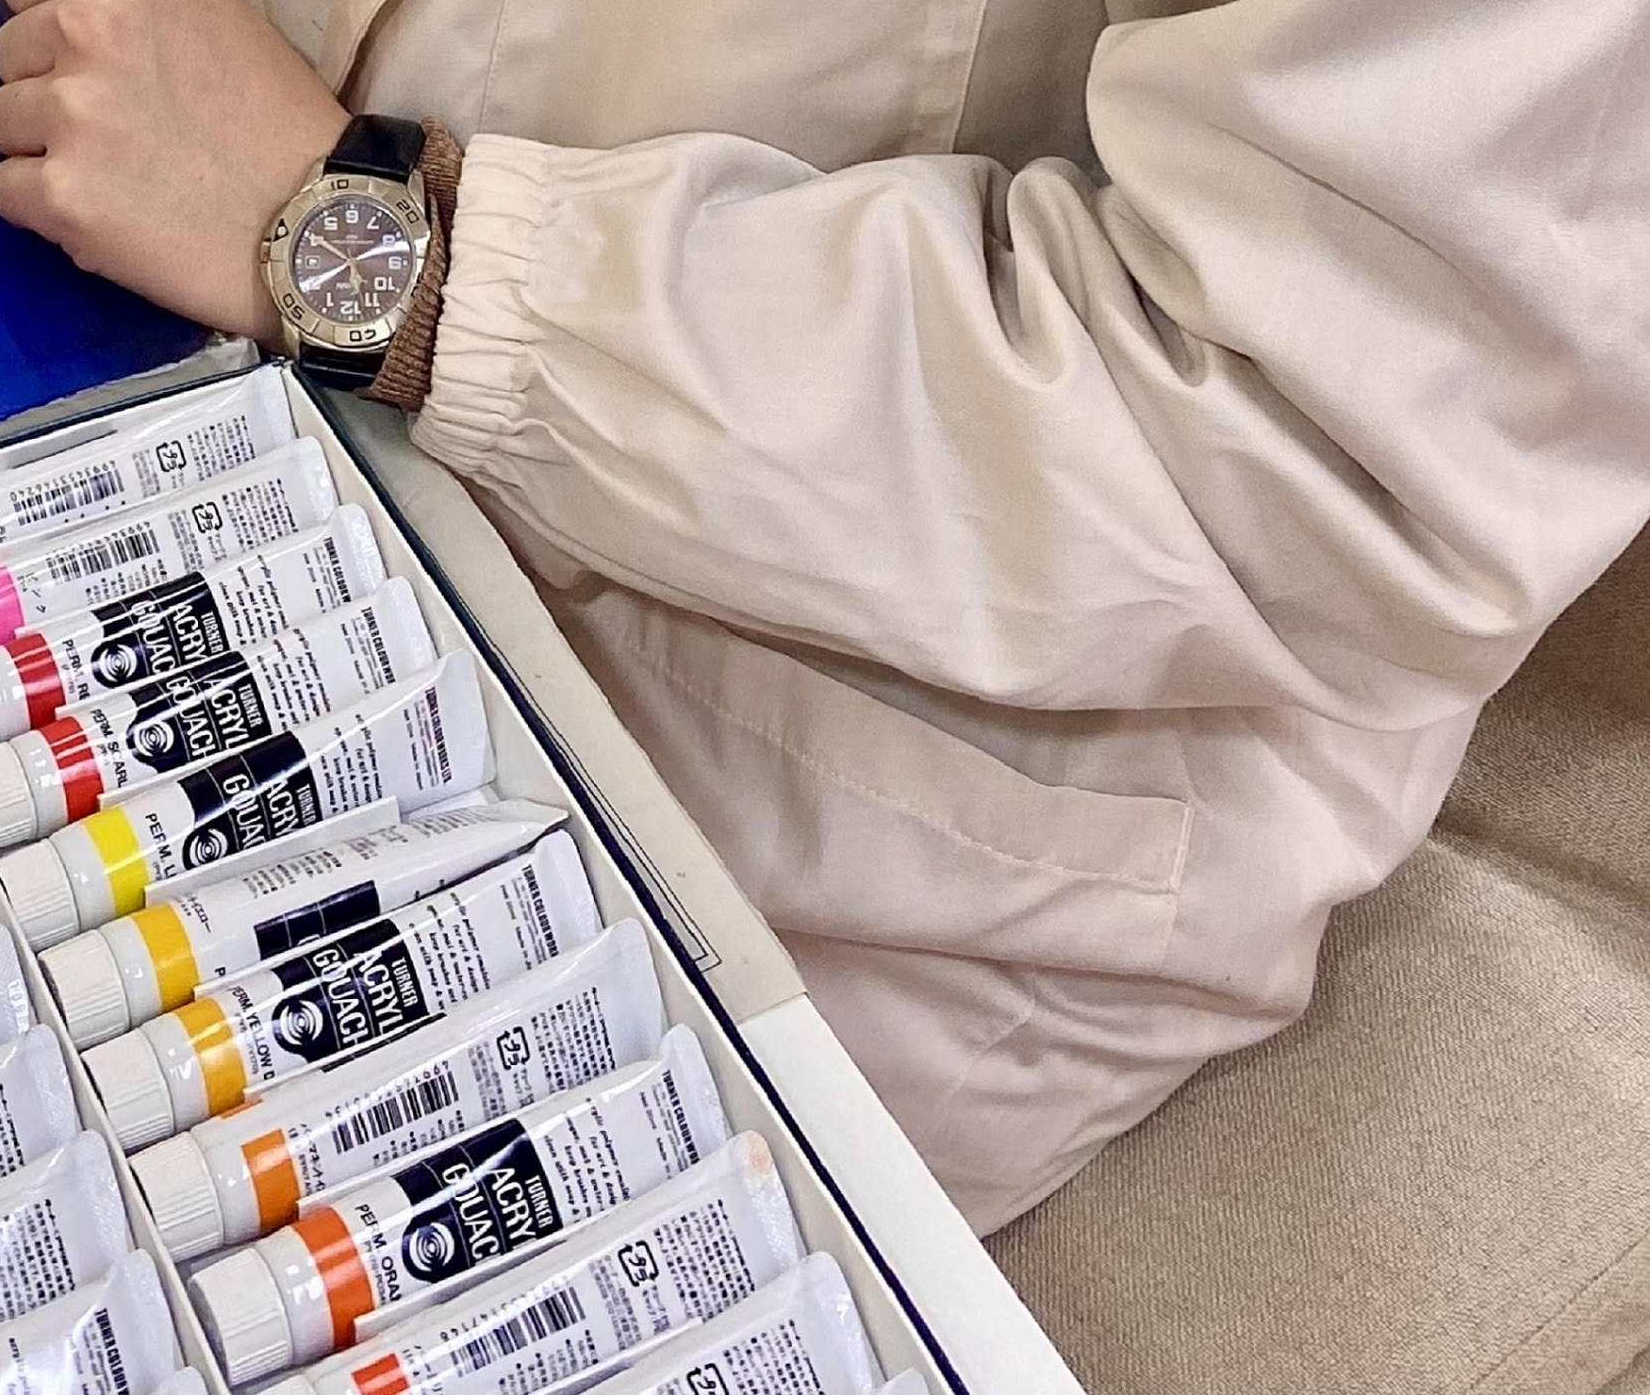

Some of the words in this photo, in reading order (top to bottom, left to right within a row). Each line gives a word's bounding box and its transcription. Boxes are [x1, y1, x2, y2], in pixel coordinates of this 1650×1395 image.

[324, 216, 339, 231] 5
[396, 199, 419, 224] 20
[374, 276, 396, 290] 10
[340, 300, 362, 314] 12
[127, 597, 179, 676] GOUAC
[166, 600, 211, 666] ACRY
[198, 610, 226, 653] TURNER
[359, 606, 381, 638] TURNER
[370, 635, 391, 667] COLOUR
[235, 683, 265, 728] TURNER
[258, 778, 303, 838] ACRY
[292, 783, 322, 825] TURNER
[519, 864, 543, 900] TURNER
[530, 898, 553, 933] COLOUR
[350, 944, 408, 1034] ACRYL
[387, 956, 421, 1008] TURNER
[501, 1037, 526, 1067] プラ
[658, 1069, 683, 1108] TURNER
[671, 1106, 695, 1144] COLOUR
[521, 1174, 557, 1228] TURNER
[626, 1250, 653, 1284] プラ
[98, 1308, 117, 1346] TURNER
